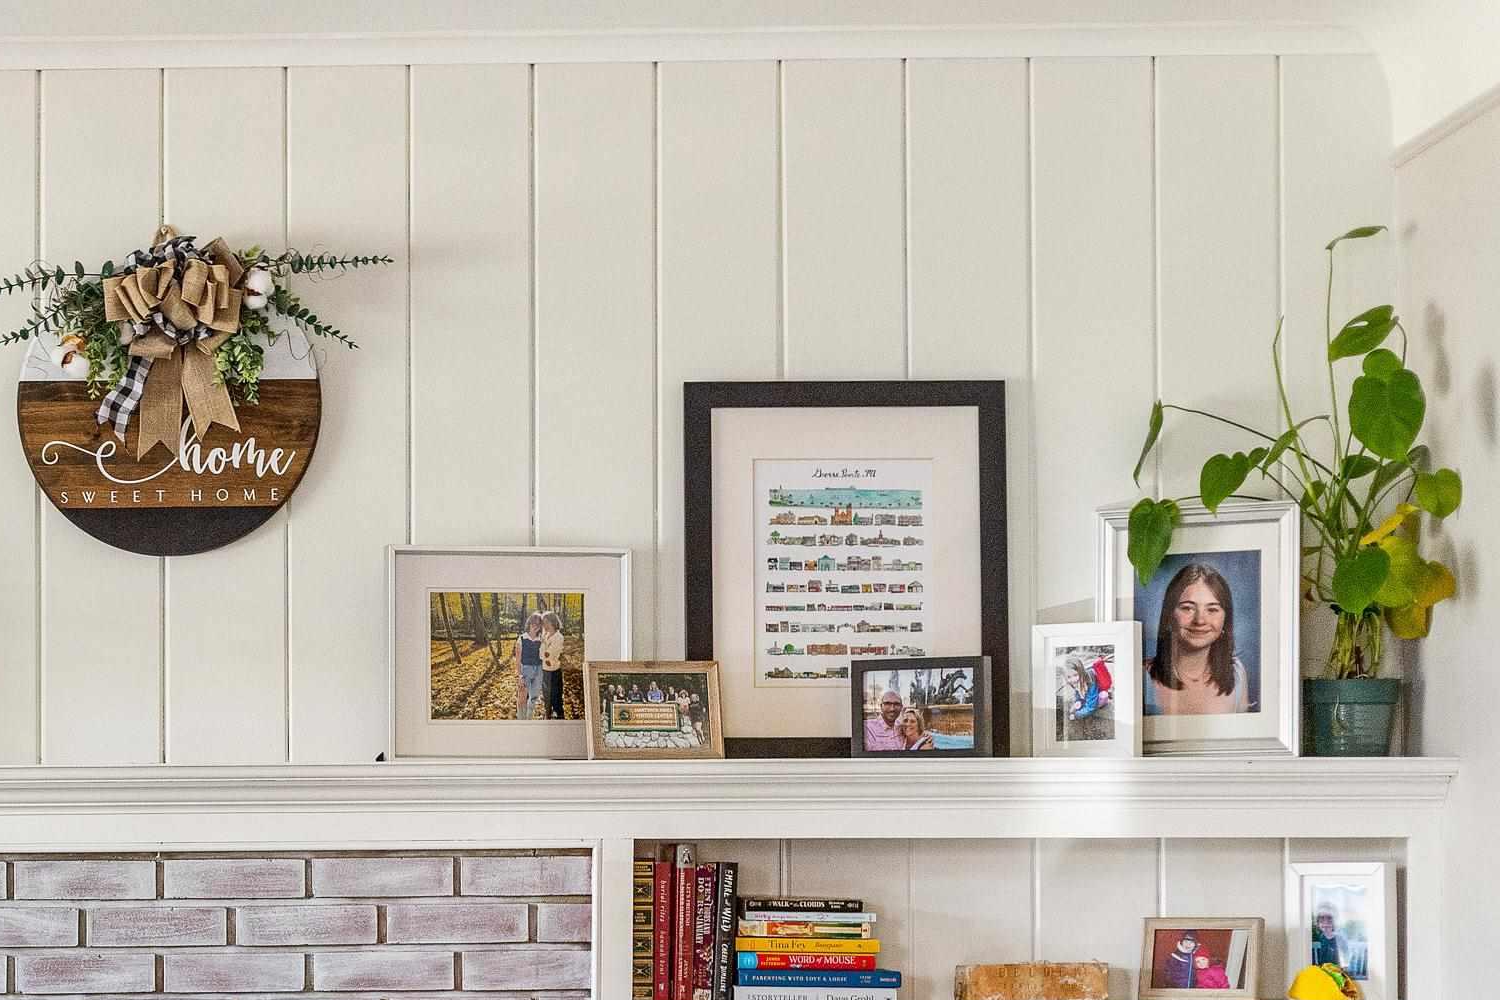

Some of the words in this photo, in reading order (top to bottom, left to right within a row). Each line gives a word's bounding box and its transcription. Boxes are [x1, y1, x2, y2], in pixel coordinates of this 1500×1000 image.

[60, 489, 164, 504] SWEET
[190, 488, 280, 502] HOME
[724, 869, 734, 898] EMPIRE
[721, 907, 733, 932] WILD
[788, 955, 815, 964] WORD
[824, 956, 857, 965] MOUSE
